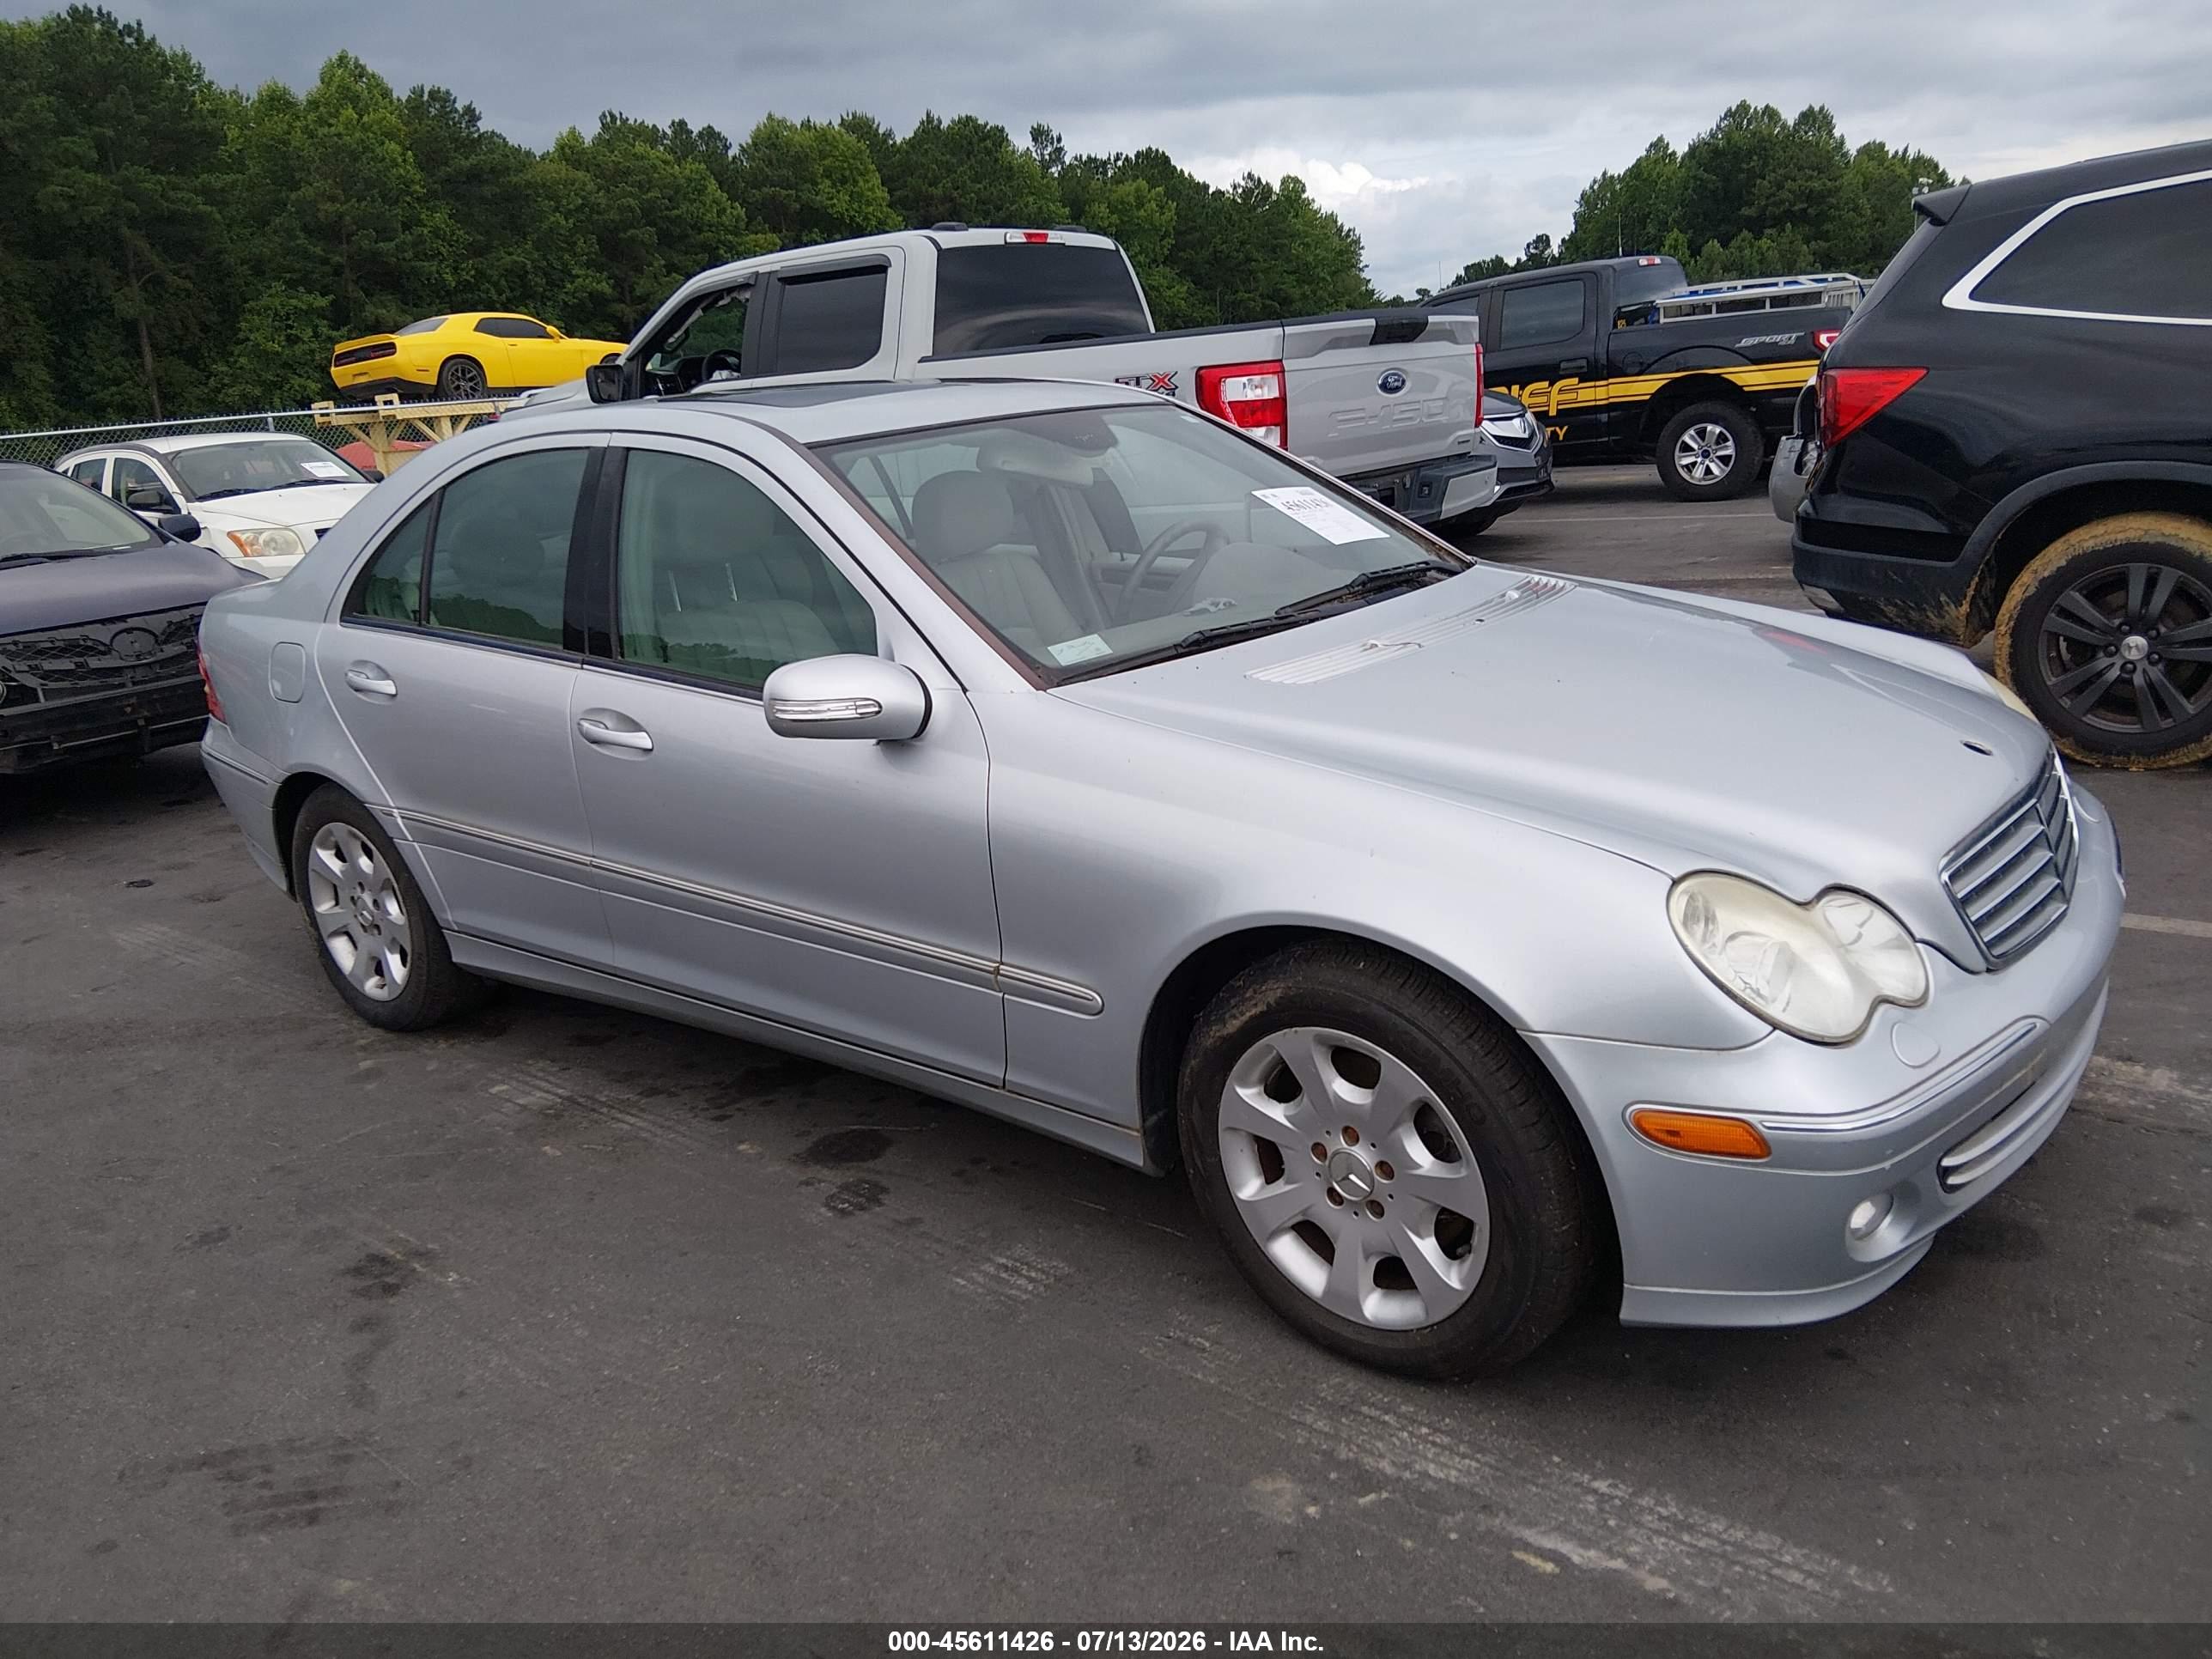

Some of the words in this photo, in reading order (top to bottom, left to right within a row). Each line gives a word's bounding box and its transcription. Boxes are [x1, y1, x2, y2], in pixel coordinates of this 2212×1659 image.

[1735, 331, 1805, 348] SPORT
[1386, 375, 1403, 390] Ford
[1545, 425, 1569, 441] TY
